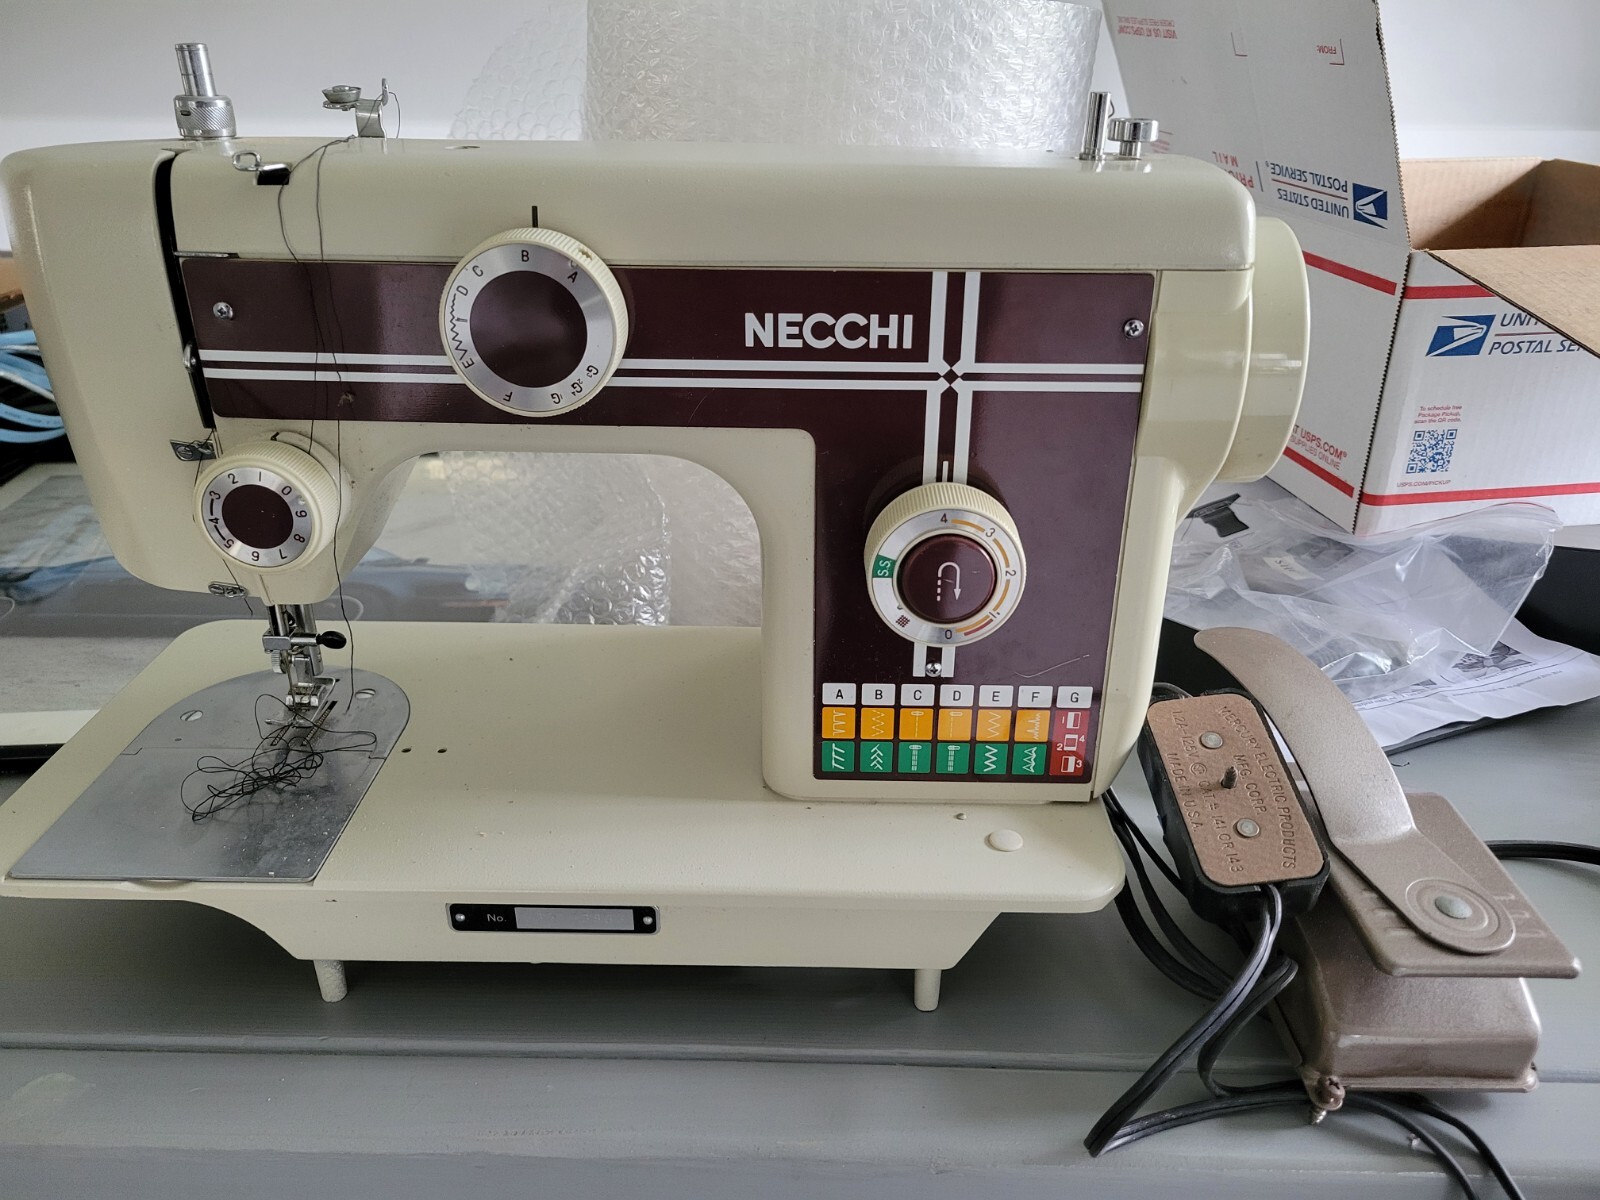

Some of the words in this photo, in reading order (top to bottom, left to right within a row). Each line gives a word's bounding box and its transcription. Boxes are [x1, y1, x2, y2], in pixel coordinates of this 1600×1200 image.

[1309, 172, 1348, 193] POSTAL
[1277, 188, 1309, 208] STATES
[1310, 197, 1350, 219] UNITED
[521, 250, 530, 262] B
[472, 265, 484, 278] C
[568, 271, 578, 284] A
[456, 285, 469, 297] D
[744, 312, 914, 349] NECCHI
[1488, 340, 1553, 356] POSTAL
[462, 358, 475, 369] E
[503, 391, 513, 402] F
[228, 473, 238, 484] 2
[209, 490, 221, 500] 3
[208, 516, 220, 524] 4
[940, 513, 948, 524] 4
[294, 534, 306, 543] 8
[985, 528, 996, 538] 3
[224, 538, 234, 549] 5
[278, 548, 288, 560] 7
[1006, 569, 1016, 577] 2
[835, 690, 844, 700] A
[875, 690, 883, 700] B
[913, 690, 922, 701] C
[953, 690, 961, 701] D
[992, 691, 1000, 702] E
[1032, 692, 1040, 702] F
[1070, 692, 1079, 703] G
[1166, 752, 1188, 782] MADE
[1178, 785, 1192, 796] IN
[1218, 706, 1260, 750] MERCURY
[1254, 752, 1287, 804] ELECTRIC
[1278, 806, 1296, 870] PRODUCTS
[1218, 833, 1234, 850] OR
[486, 913, 507, 922] No.
